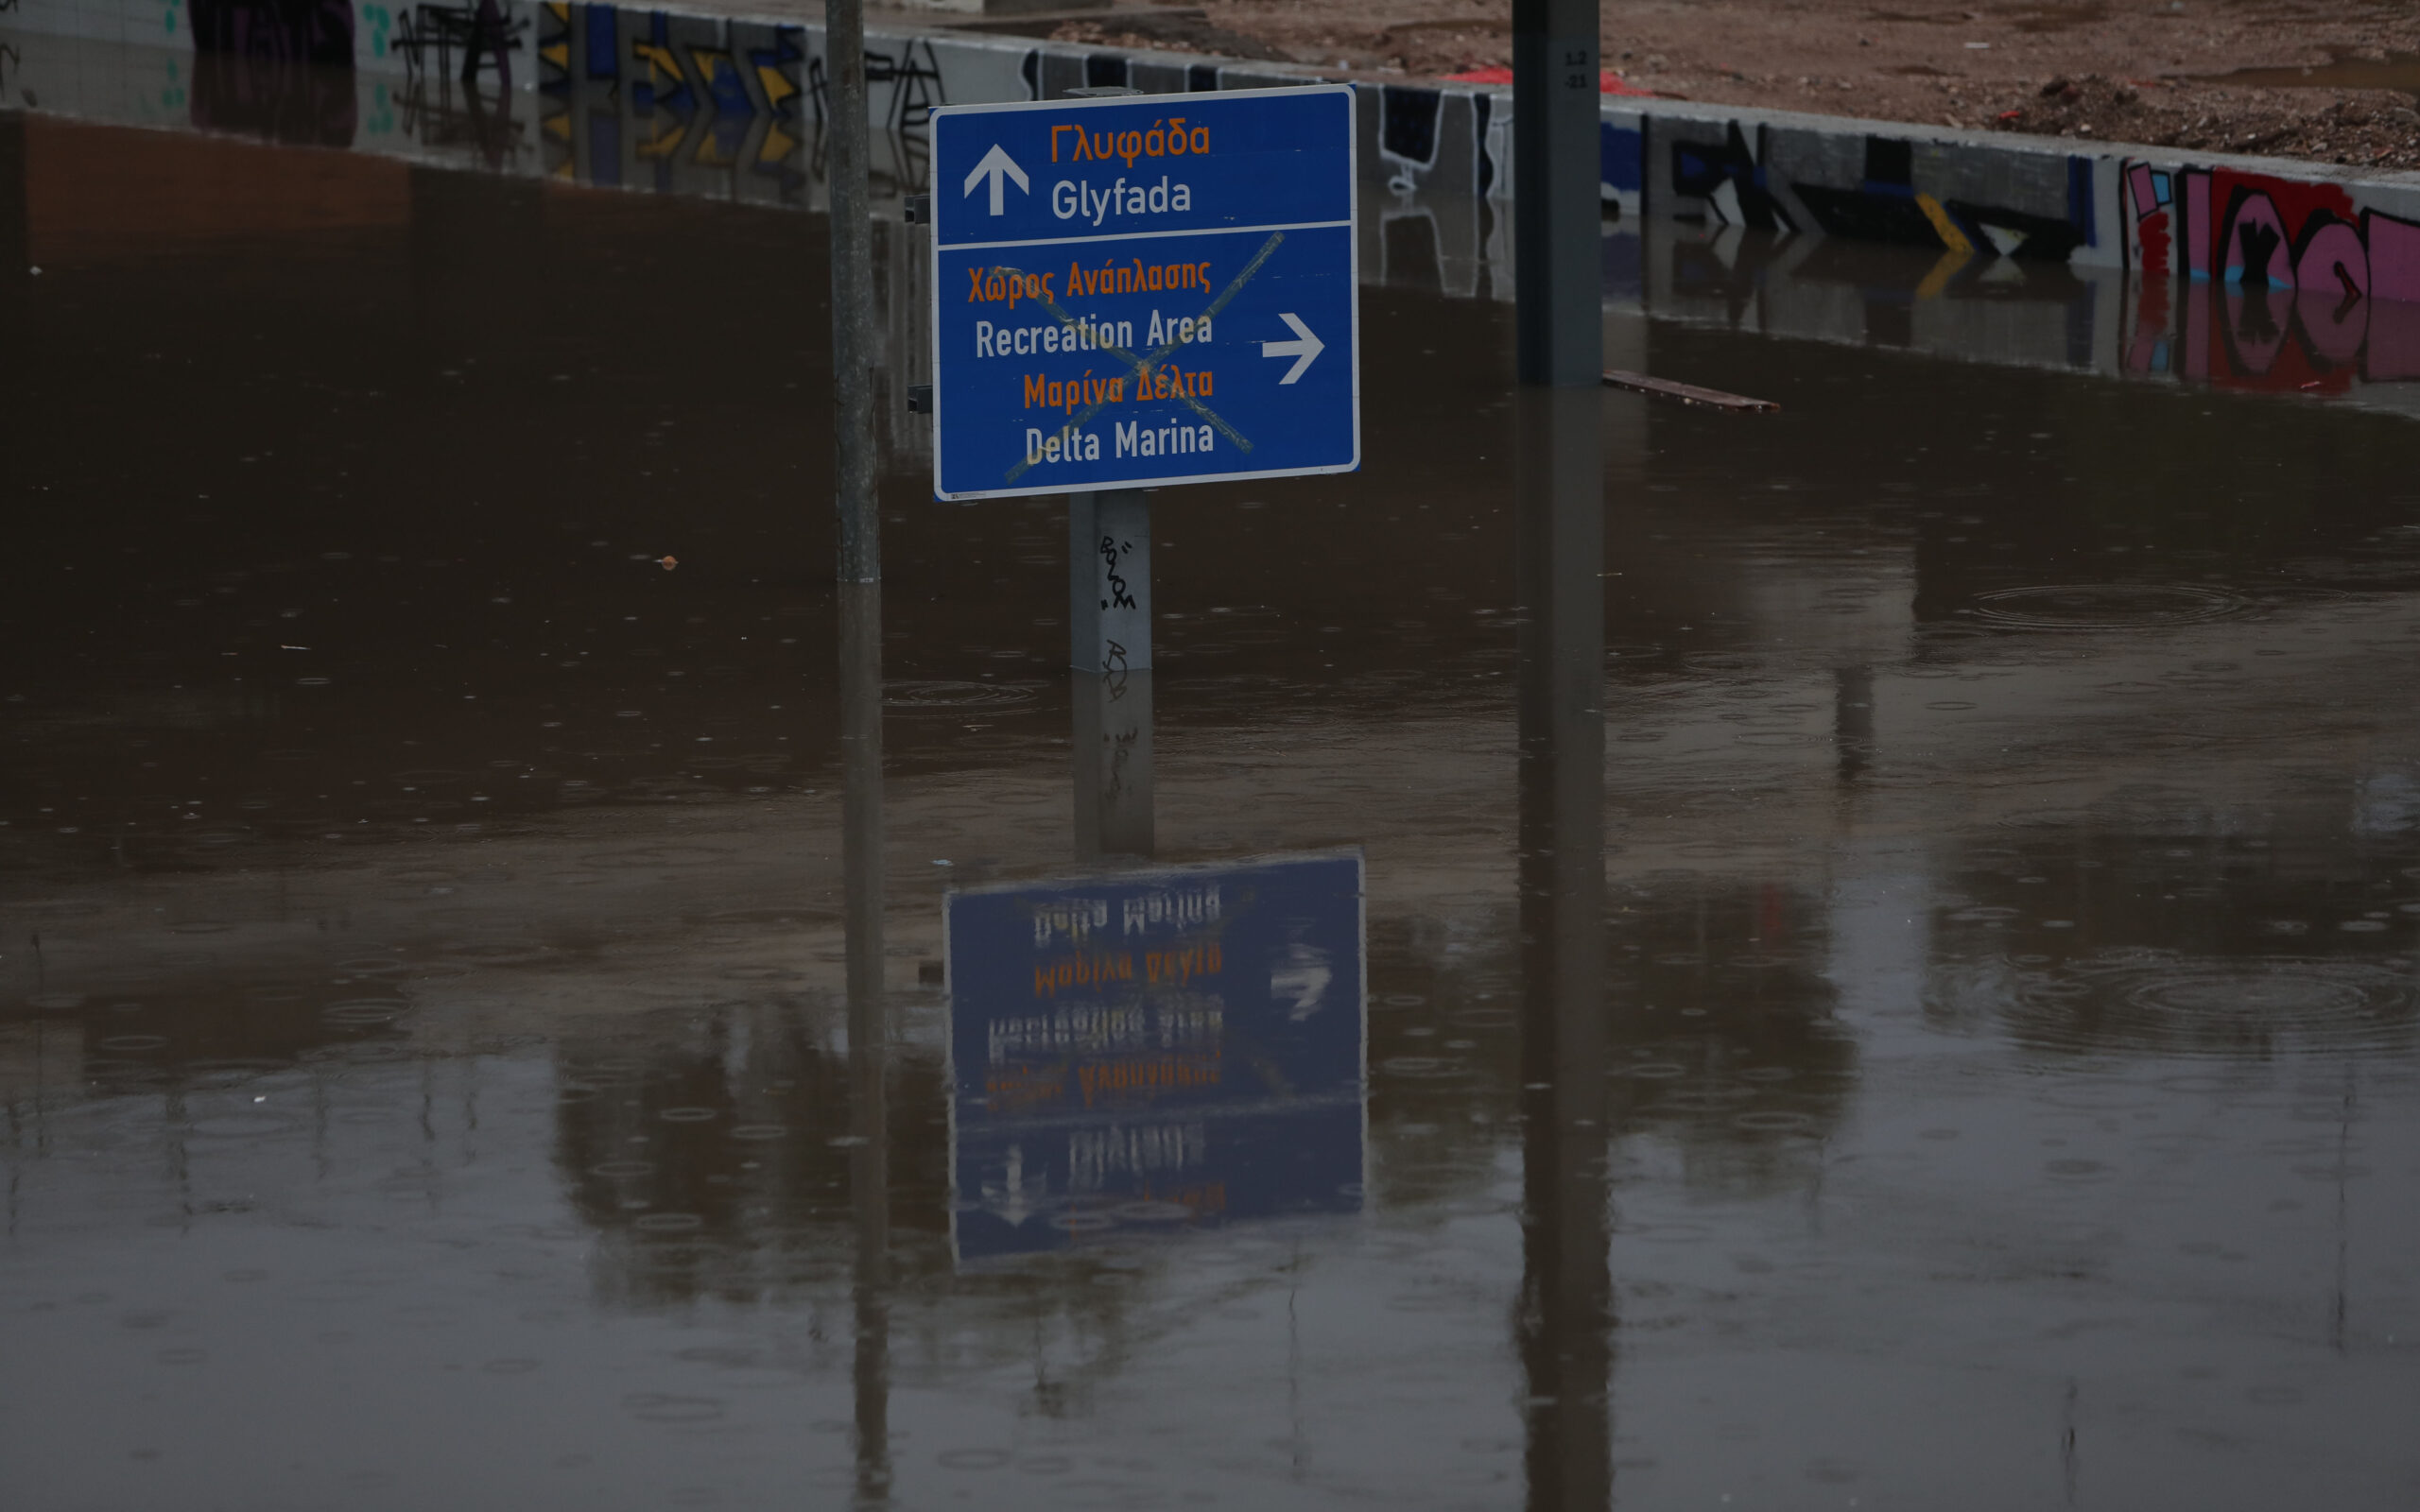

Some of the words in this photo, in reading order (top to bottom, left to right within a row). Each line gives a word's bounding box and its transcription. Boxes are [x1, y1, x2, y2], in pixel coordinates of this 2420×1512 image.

[1051, 117, 1210, 168] Γλυφάδα
[1052, 175, 1191, 227] Glyfada
[968, 266, 1055, 310] Χώρος
[1066, 258, 1211, 297] Ανάπλασης
[976, 313, 1132, 358] Recreation
[1146, 309, 1213, 347] Area
[1024, 369, 1123, 415] Μαρίνα
[1136, 365, 1214, 402] Δέλτα
[1026, 424, 1100, 466] Delta
[1115, 417, 1214, 458] Marina
